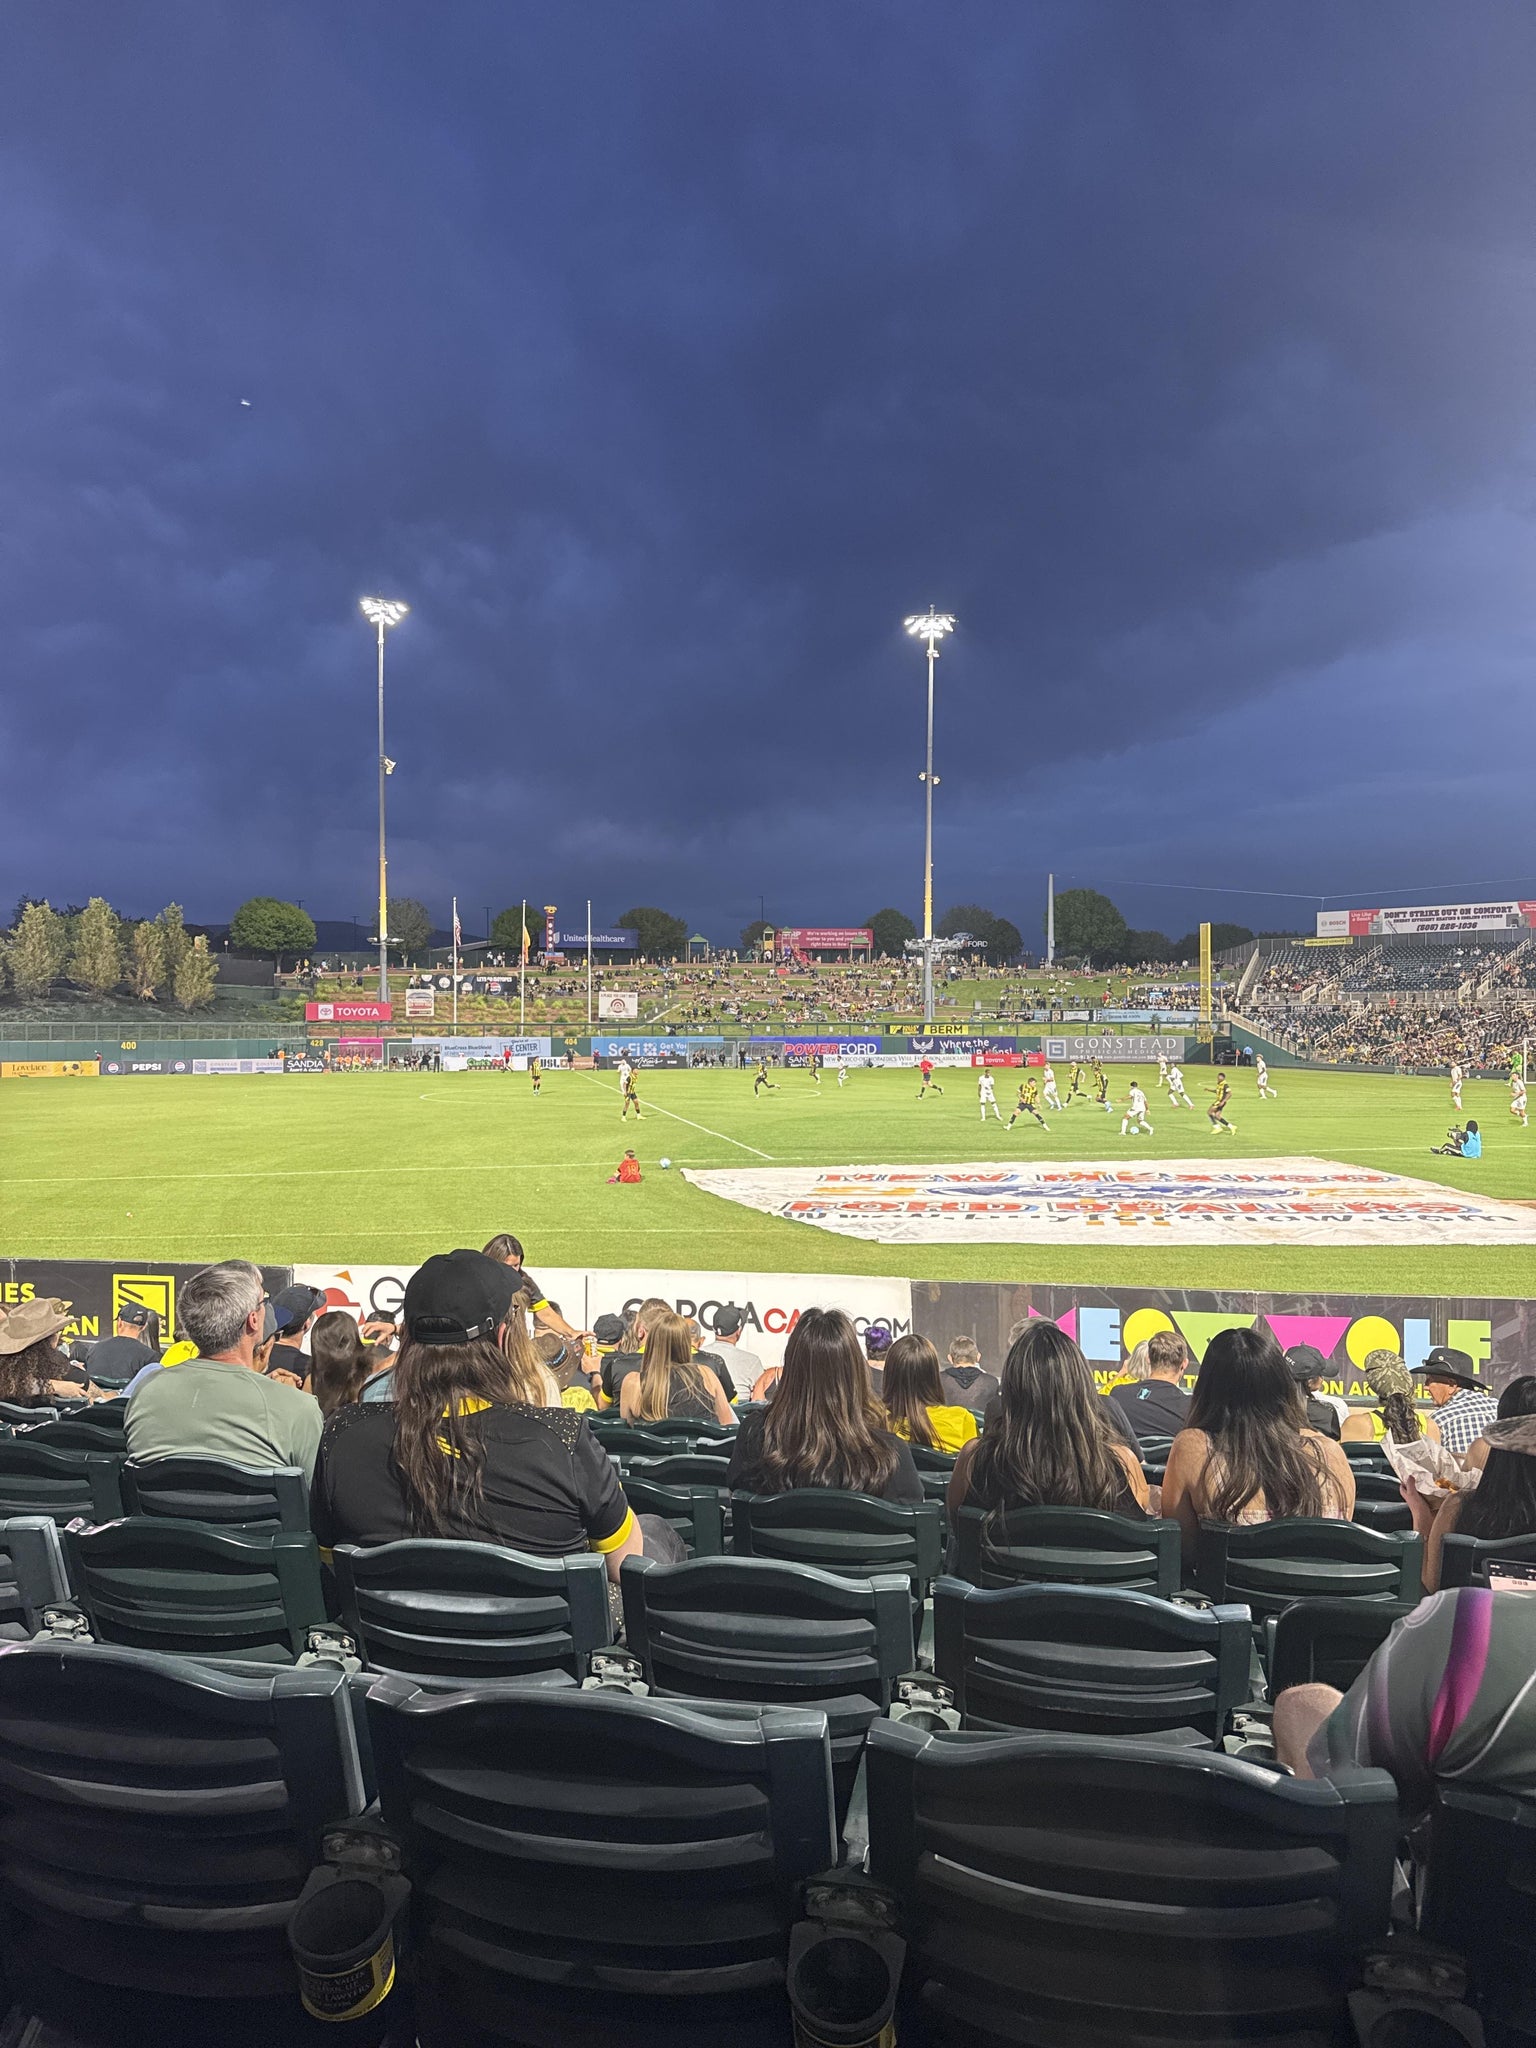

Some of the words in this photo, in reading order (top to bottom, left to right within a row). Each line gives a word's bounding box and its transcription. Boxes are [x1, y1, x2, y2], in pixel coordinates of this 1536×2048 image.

[1384, 911, 1407, 919] DON'T
[1409, 910, 1439, 918] STRIKE
[1442, 908, 1458, 916] OUT
[1473, 905, 1513, 914] COMFORT
[1416, 923, 1438, 932] (505)
[336, 1007, 379, 1016] TOYOTA
[930, 1025, 963, 1034] BERM
[121, 1041, 136, 1050] 400
[515, 1042, 538, 1052] CENTER
[939, 1039, 972, 1049] Where
[973, 1038, 990, 1047] the
[1074, 1038, 1177, 1049] GONSTEAD
[608, 1042, 641, 1056] SoFi
[286, 1060, 325, 1068] SANDIA
[787, 1056, 821, 1064] SANA
[12, 1064, 47, 1072] Lovelace
[132, 1063, 162, 1072] PEPSI
